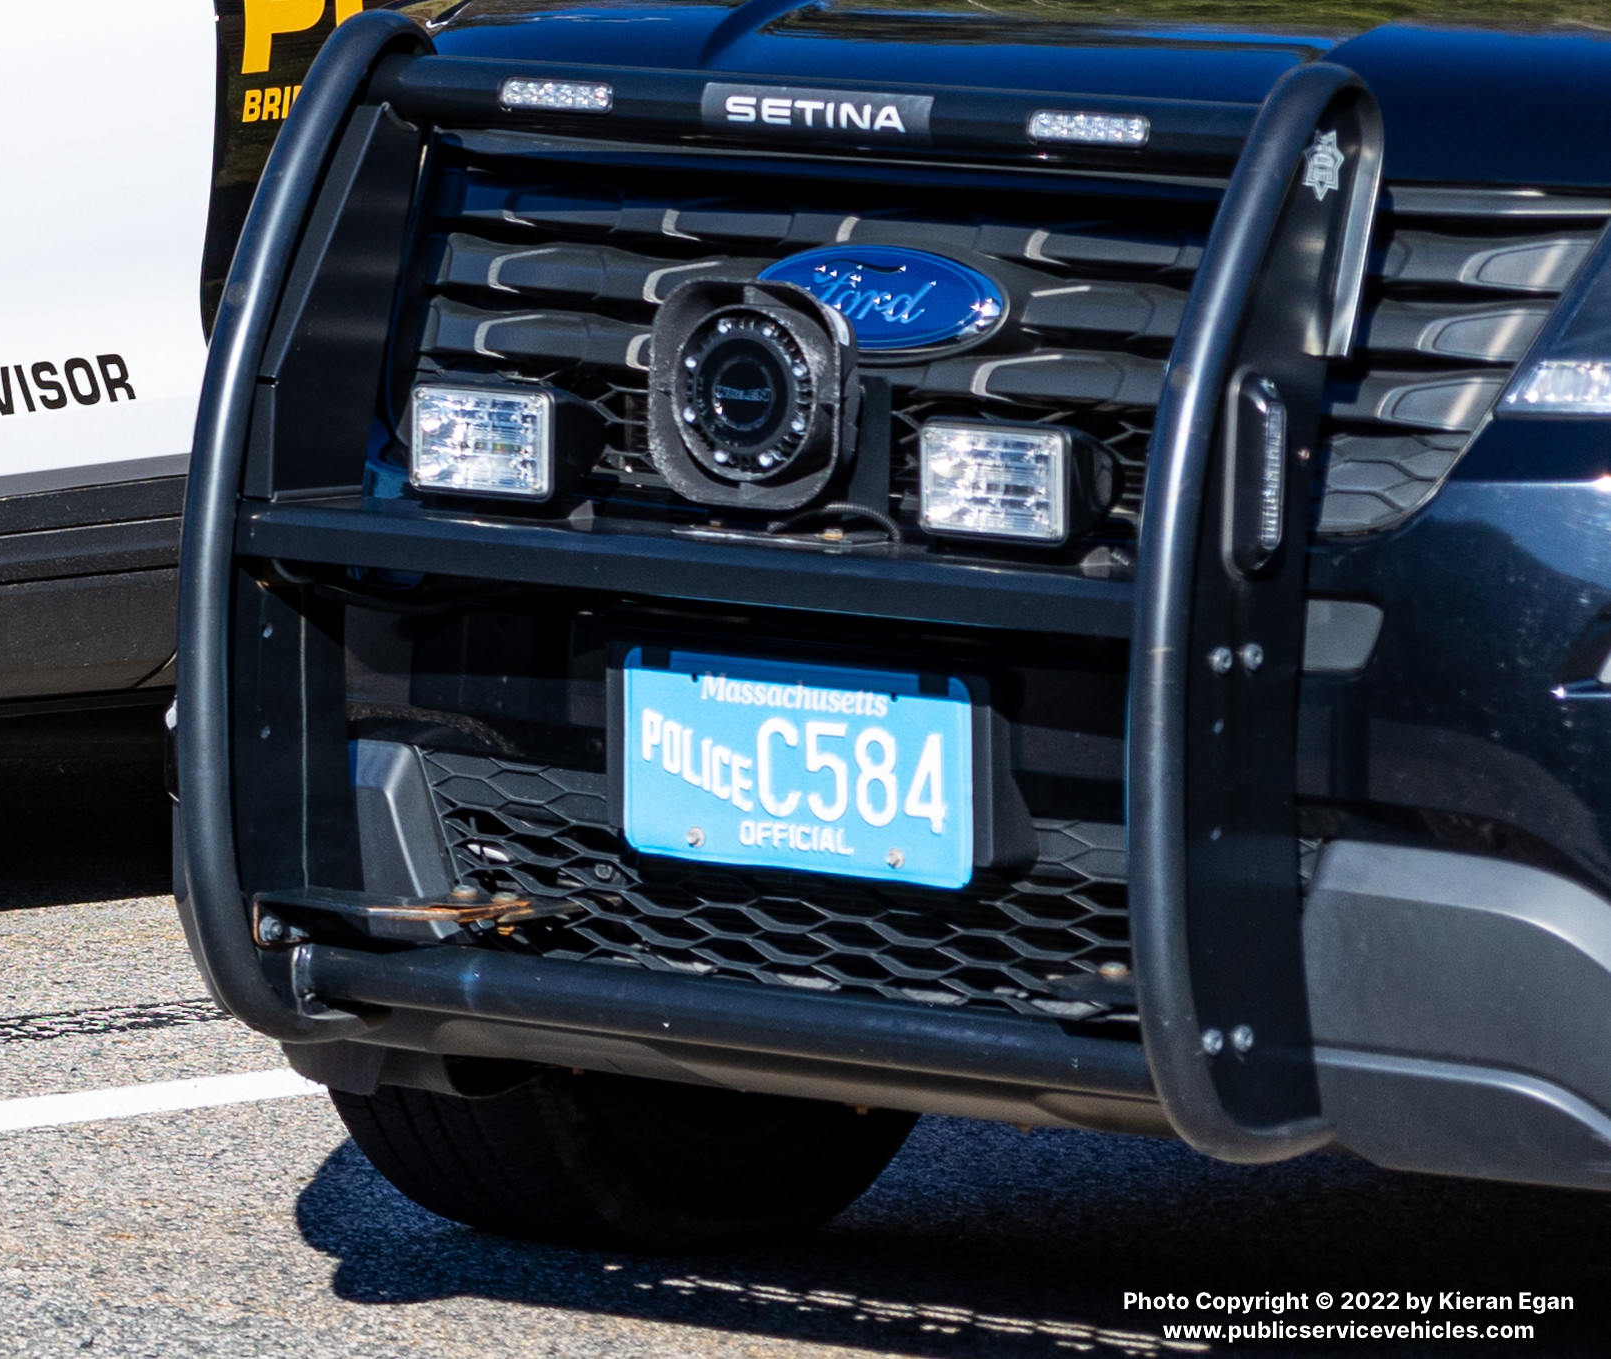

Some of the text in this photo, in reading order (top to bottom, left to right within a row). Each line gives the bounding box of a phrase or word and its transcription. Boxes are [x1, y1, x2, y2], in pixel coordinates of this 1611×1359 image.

[725, 96, 906, 133] SETINA
[804, 258, 936, 325] Ford
[701, 672, 888, 717] Massachusetts
[642, 708, 947, 835] POLICE C584
[740, 820, 854, 855] OFFICIAL
